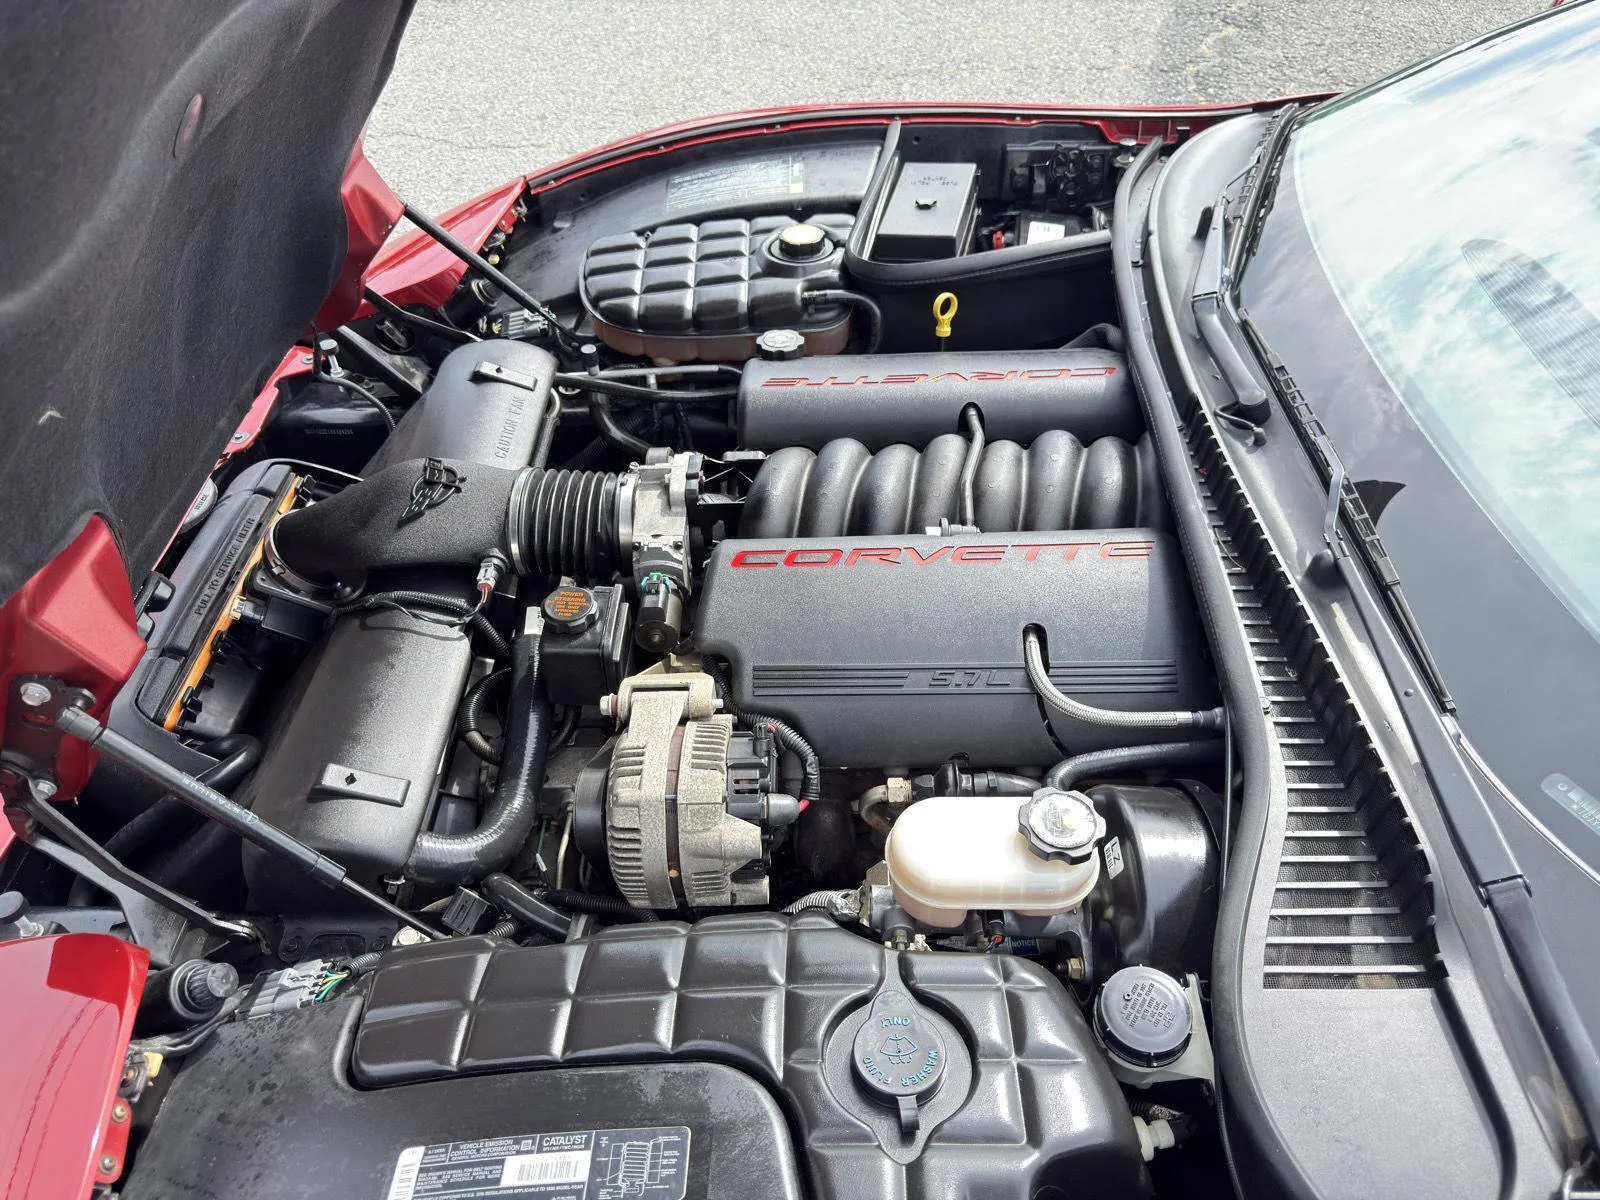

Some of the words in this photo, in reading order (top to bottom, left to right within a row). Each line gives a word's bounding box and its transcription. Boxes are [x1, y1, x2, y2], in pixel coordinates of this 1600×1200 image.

[761, 367, 1116, 387] CORVETTE
[494, 418, 519, 459] CAUTION
[508, 394, 526, 416] FAN
[730, 540, 1155, 568] CORVETTE
[194, 594, 212, 616] PULL
[208, 578, 220, 594] TO
[216, 546, 240, 580] SERVICE
[236, 517, 256, 543] FILTER
[928, 668, 1011, 688] 5.7L
[182, 778, 241, 814] STABILUS
[881, 1016, 910, 1028] ONLY
[862, 1056, 892, 1085] FLUID
[901, 1050, 938, 1086] WASHER
[450, 1149, 478, 1157] CONTROL
[480, 1144, 520, 1154] INFORMATION
[460, 1142, 484, 1150] VEHICLE
[484, 1140, 514, 1148] EMISSION
[542, 1134, 588, 1146] CATALYST
